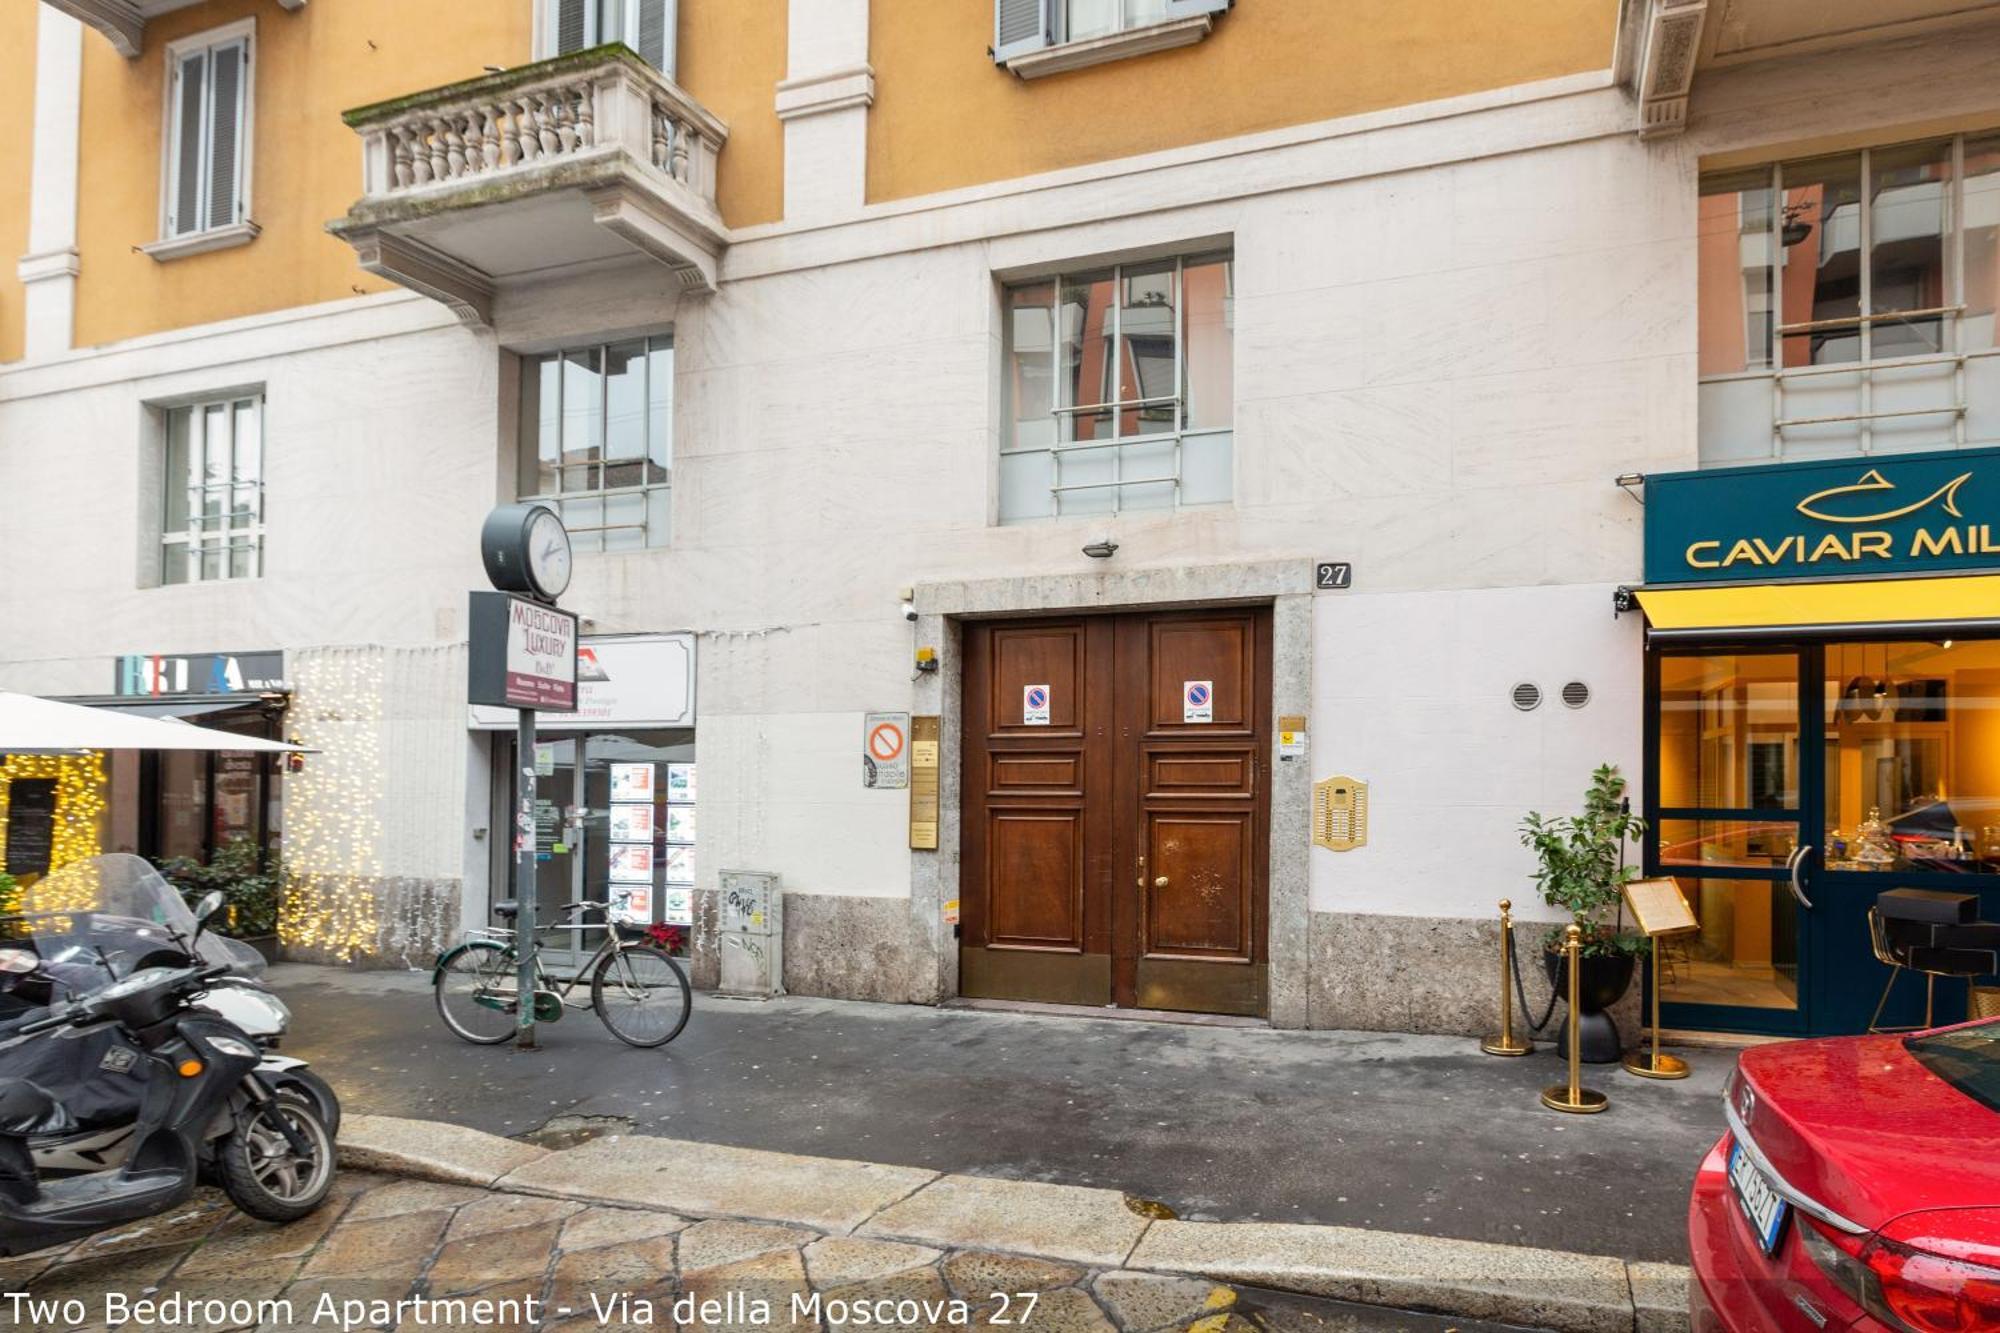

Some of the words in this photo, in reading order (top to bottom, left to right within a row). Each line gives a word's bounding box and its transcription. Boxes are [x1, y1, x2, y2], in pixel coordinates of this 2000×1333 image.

[1686, 530, 1893, 568] CAVIAR
[1910, 525, 2000, 557] MIL
[1320, 565, 1348, 586] 27
[512, 602, 571, 638] MOSCOVA
[523, 628, 567, 658] LUXURY
